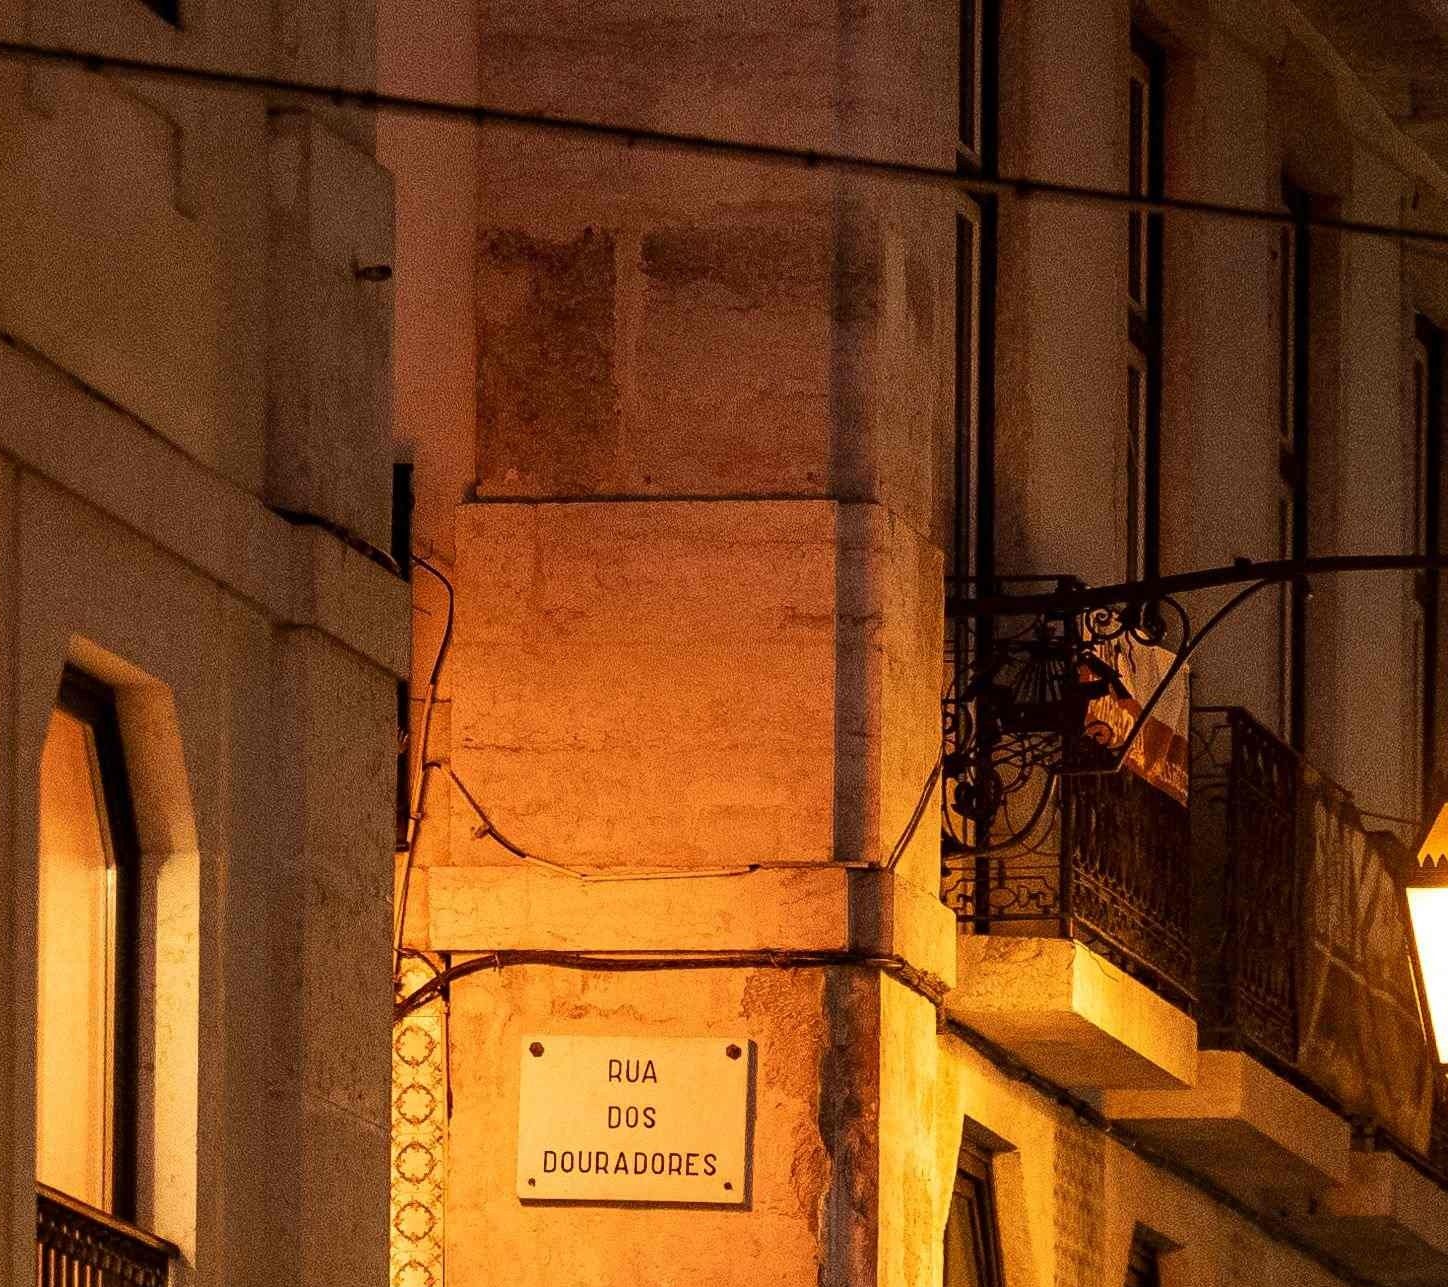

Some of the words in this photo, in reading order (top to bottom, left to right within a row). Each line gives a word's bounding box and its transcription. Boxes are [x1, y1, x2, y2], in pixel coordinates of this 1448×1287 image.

[608, 1059, 657, 1083] RUA
[608, 1106, 656, 1129] DOS
[544, 1151, 717, 1176] DOURADORES
